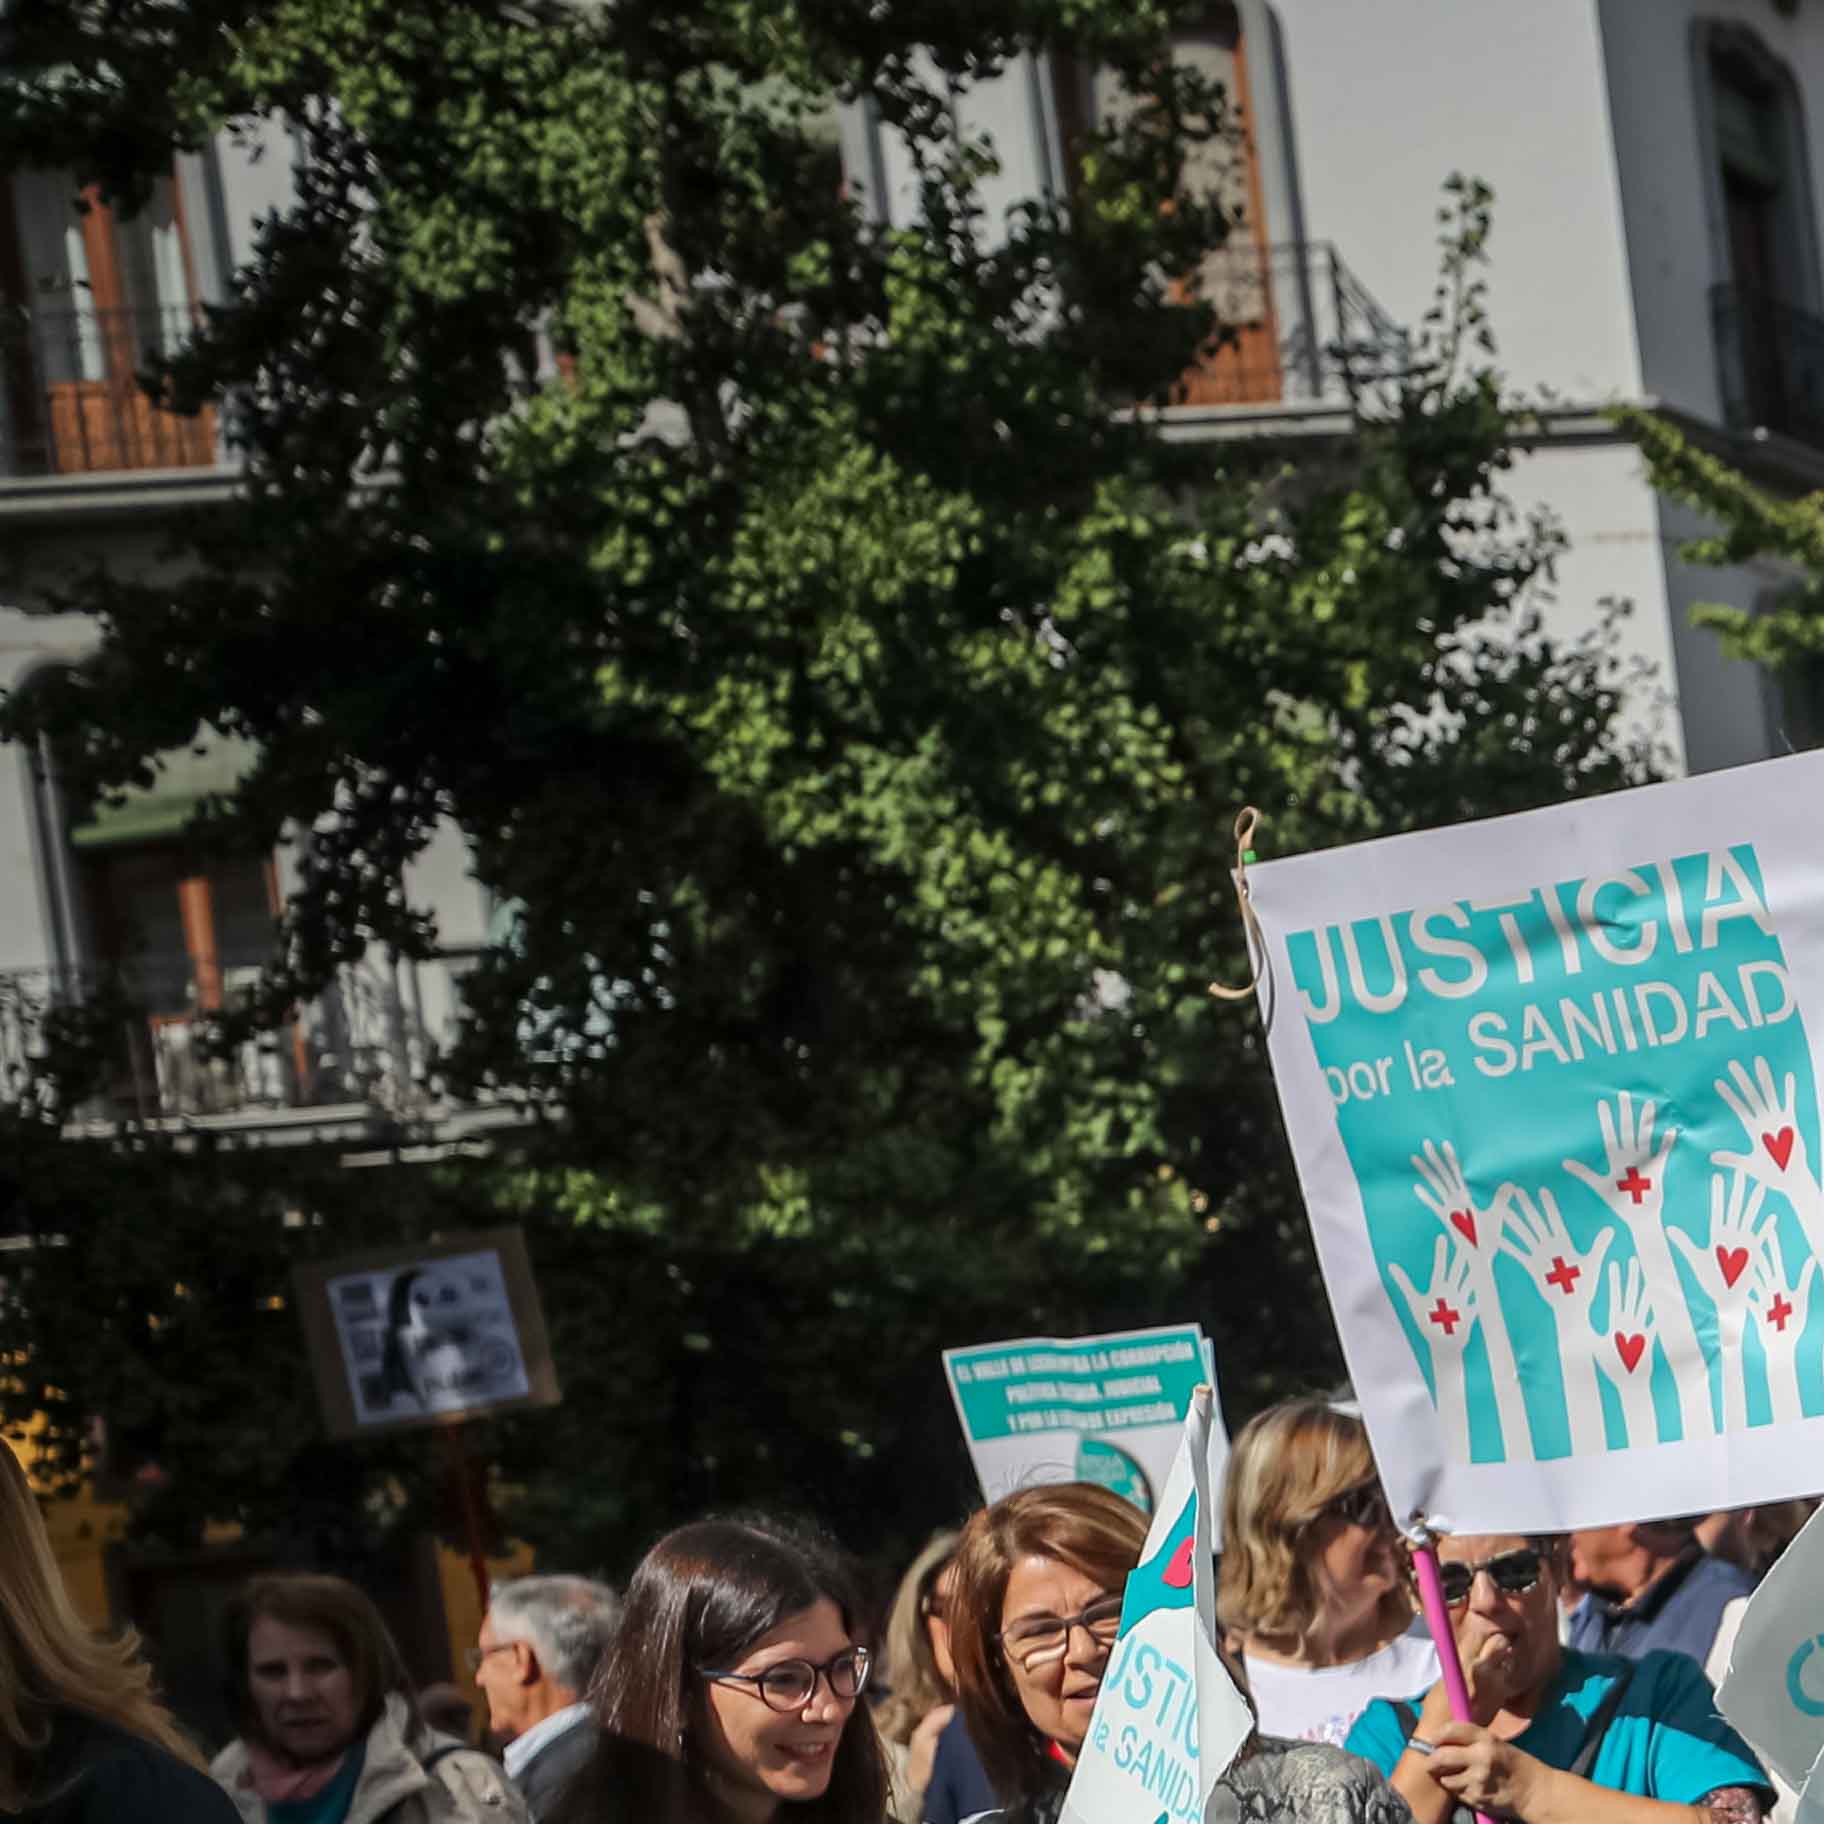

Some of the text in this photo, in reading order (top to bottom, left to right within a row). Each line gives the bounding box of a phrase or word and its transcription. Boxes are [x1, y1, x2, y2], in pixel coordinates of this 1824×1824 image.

[1295, 845, 1778, 1023] JUSTICIA
[1325, 960, 1797, 1106] por la SANIDAD
